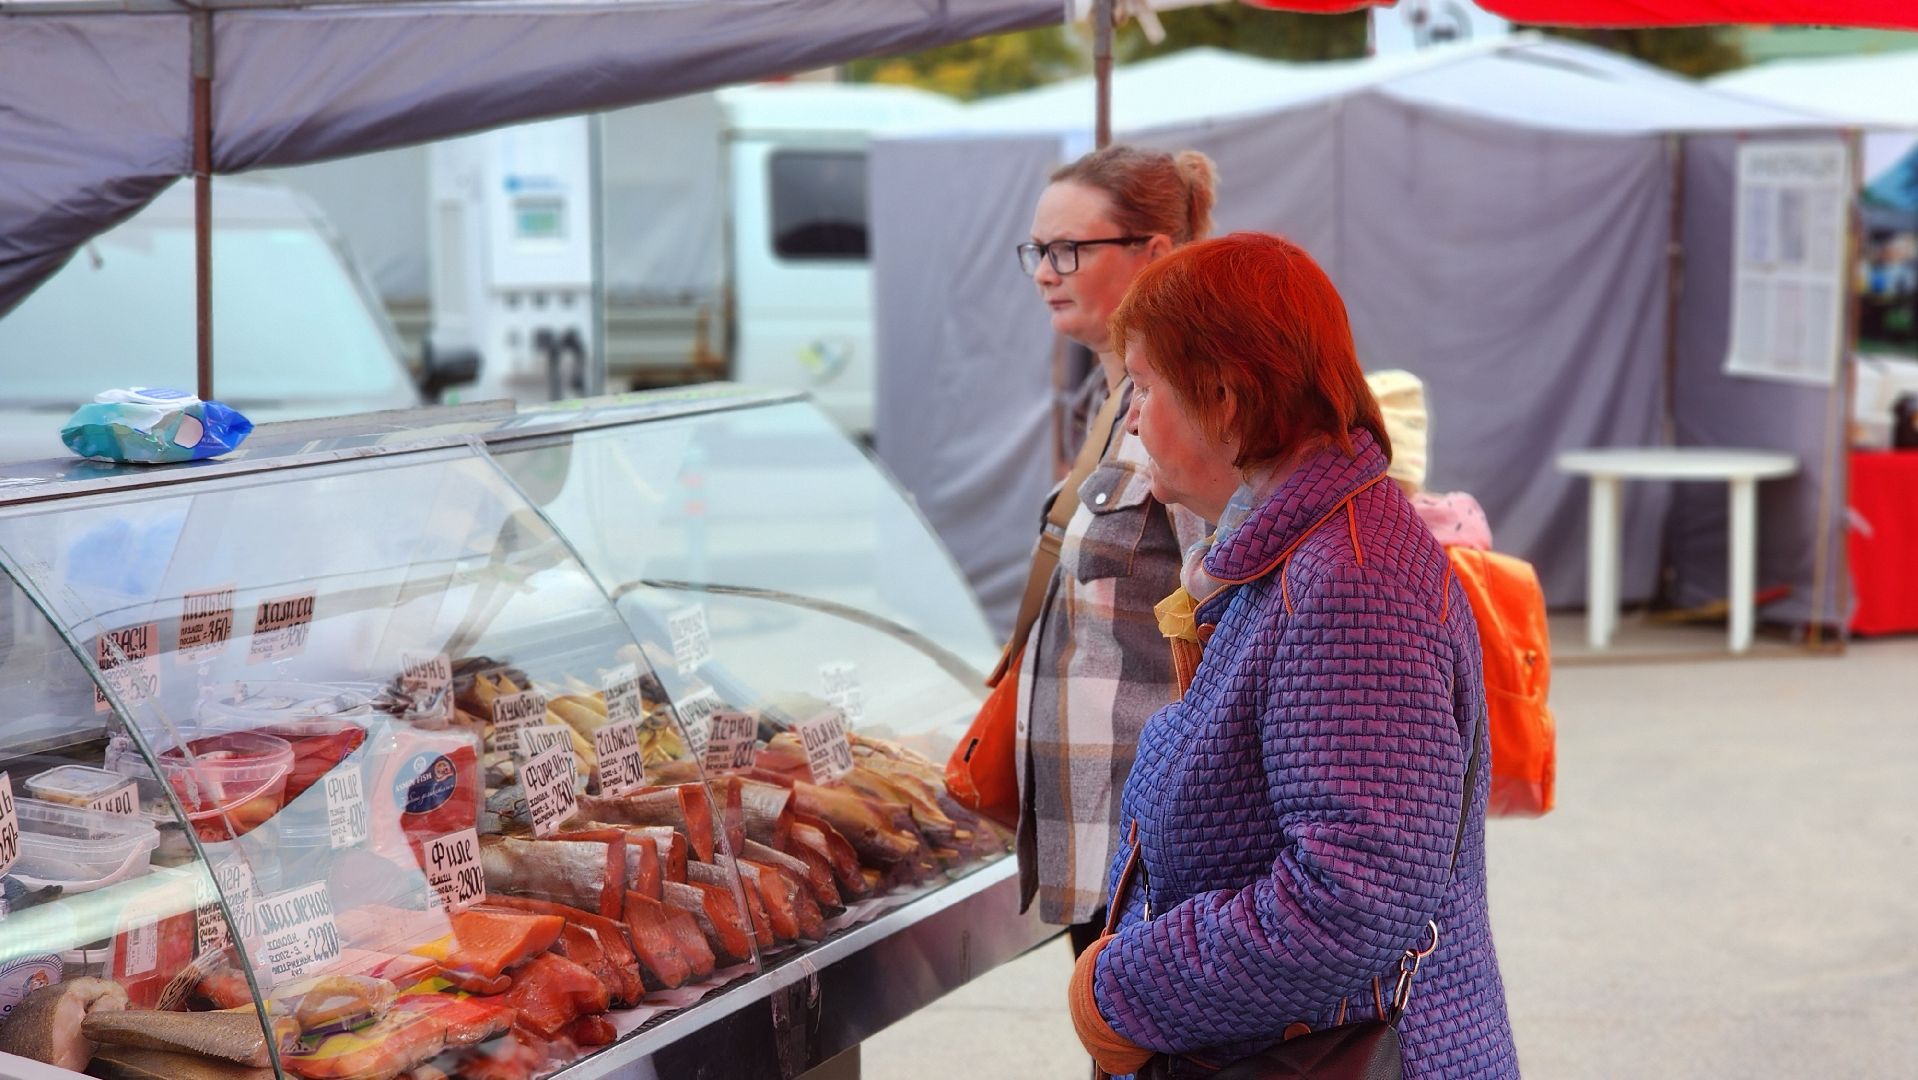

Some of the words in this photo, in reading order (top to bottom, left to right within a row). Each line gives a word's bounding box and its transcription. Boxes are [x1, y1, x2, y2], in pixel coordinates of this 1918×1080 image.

[401, 652, 446, 681] Окунь
[525, 754, 568, 791] Форель
[431, 838, 474, 871] Филе
